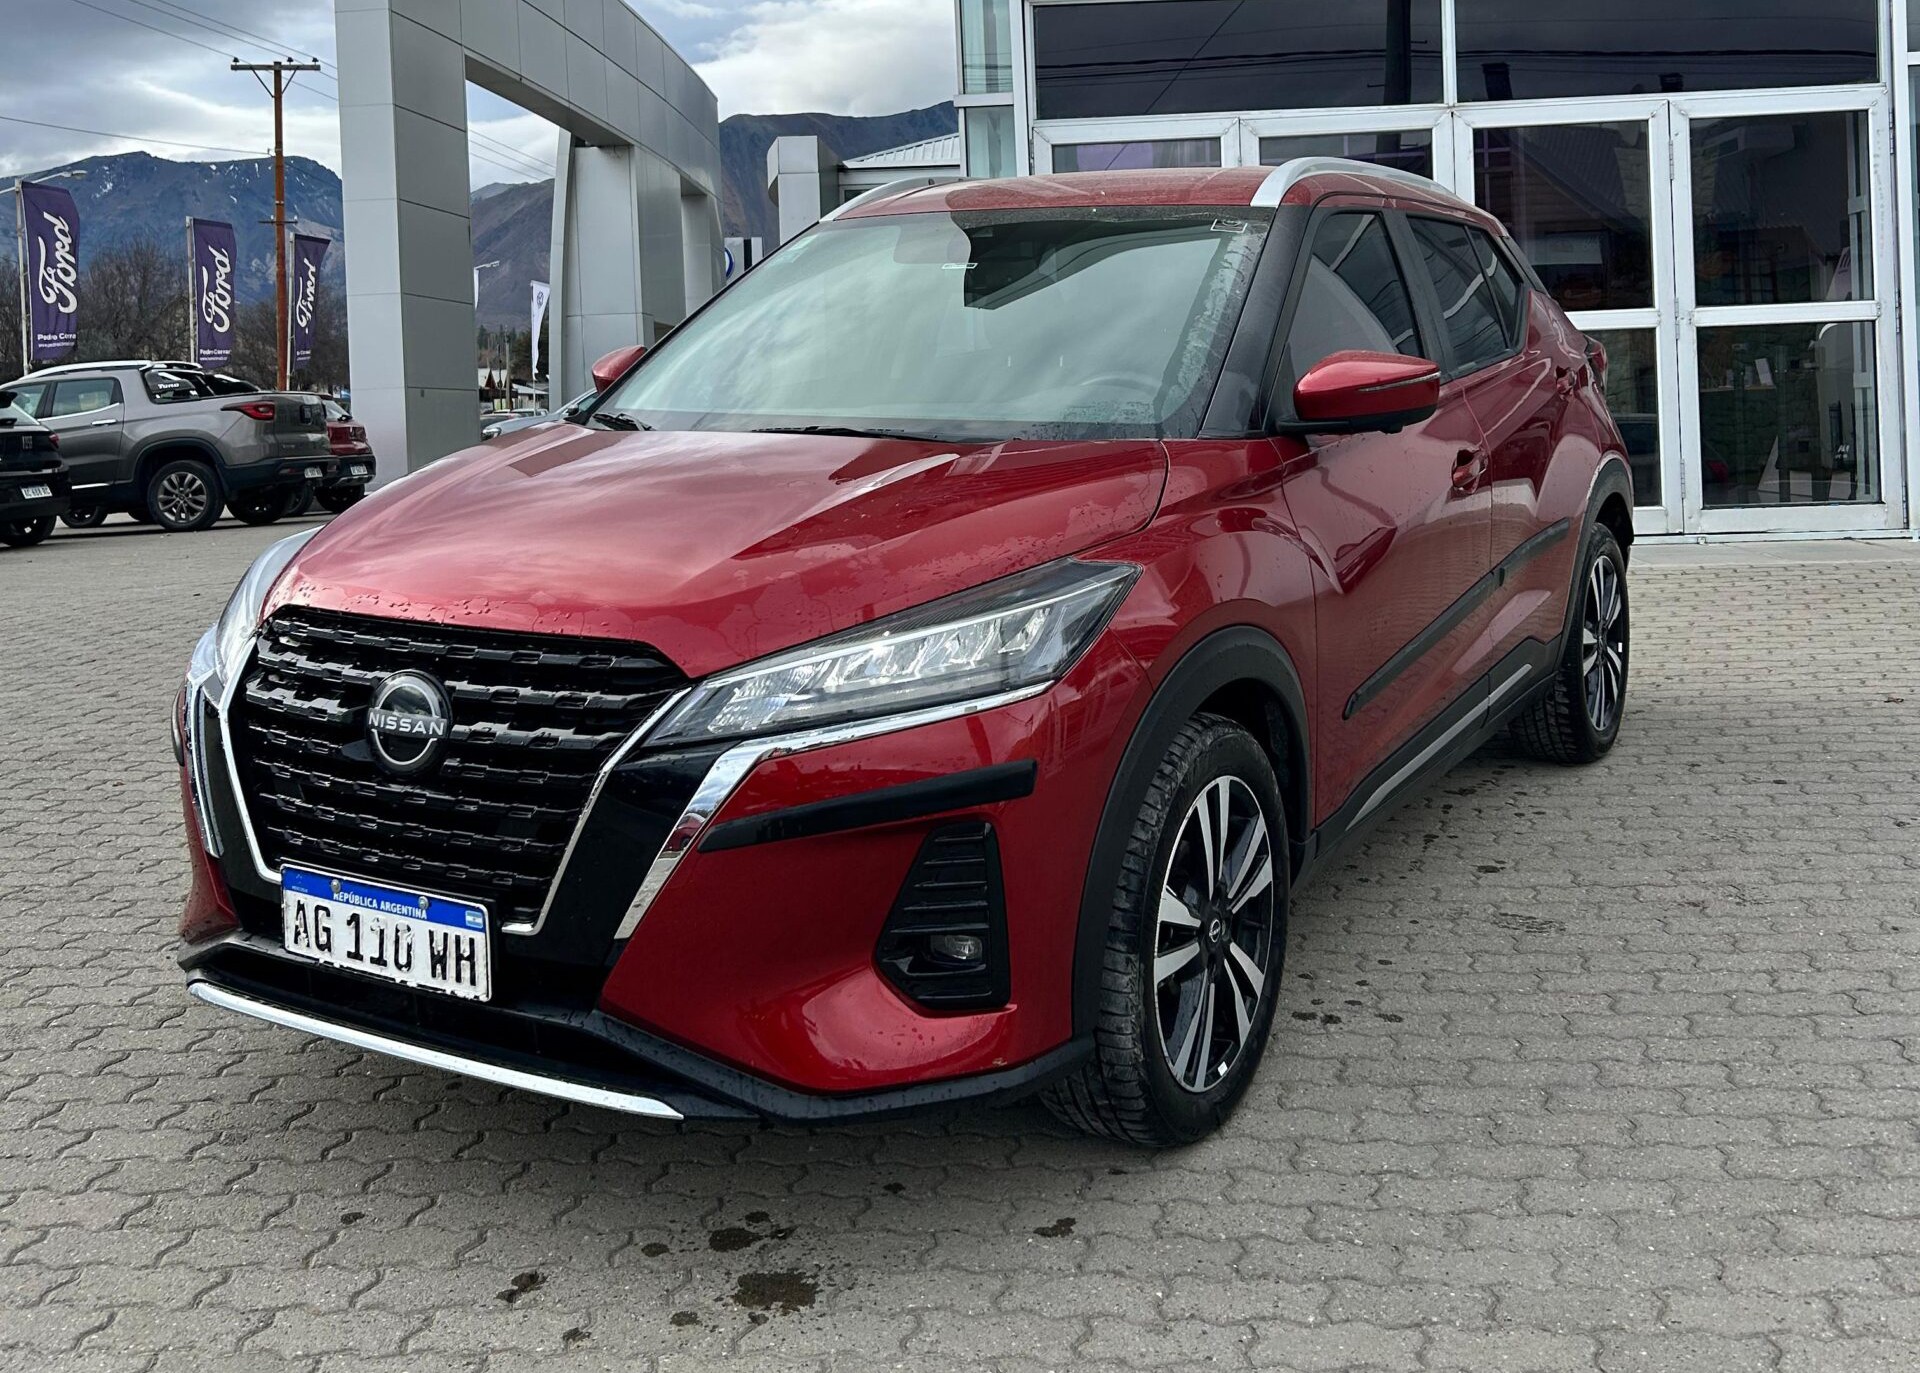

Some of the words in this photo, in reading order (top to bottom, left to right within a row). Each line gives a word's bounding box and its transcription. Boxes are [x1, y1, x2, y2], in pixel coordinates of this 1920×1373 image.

[38, 211, 77, 313] Ford
[202, 245, 231, 332] Ford
[368, 712, 444, 735] NISSAN
[294, 900, 332, 953] AG
[347, 912, 412, 972] 110
[428, 929, 476, 986] WH
[333, 891, 378, 909] REPÚBLICA
[380, 900, 427, 920] ARGENTINA
